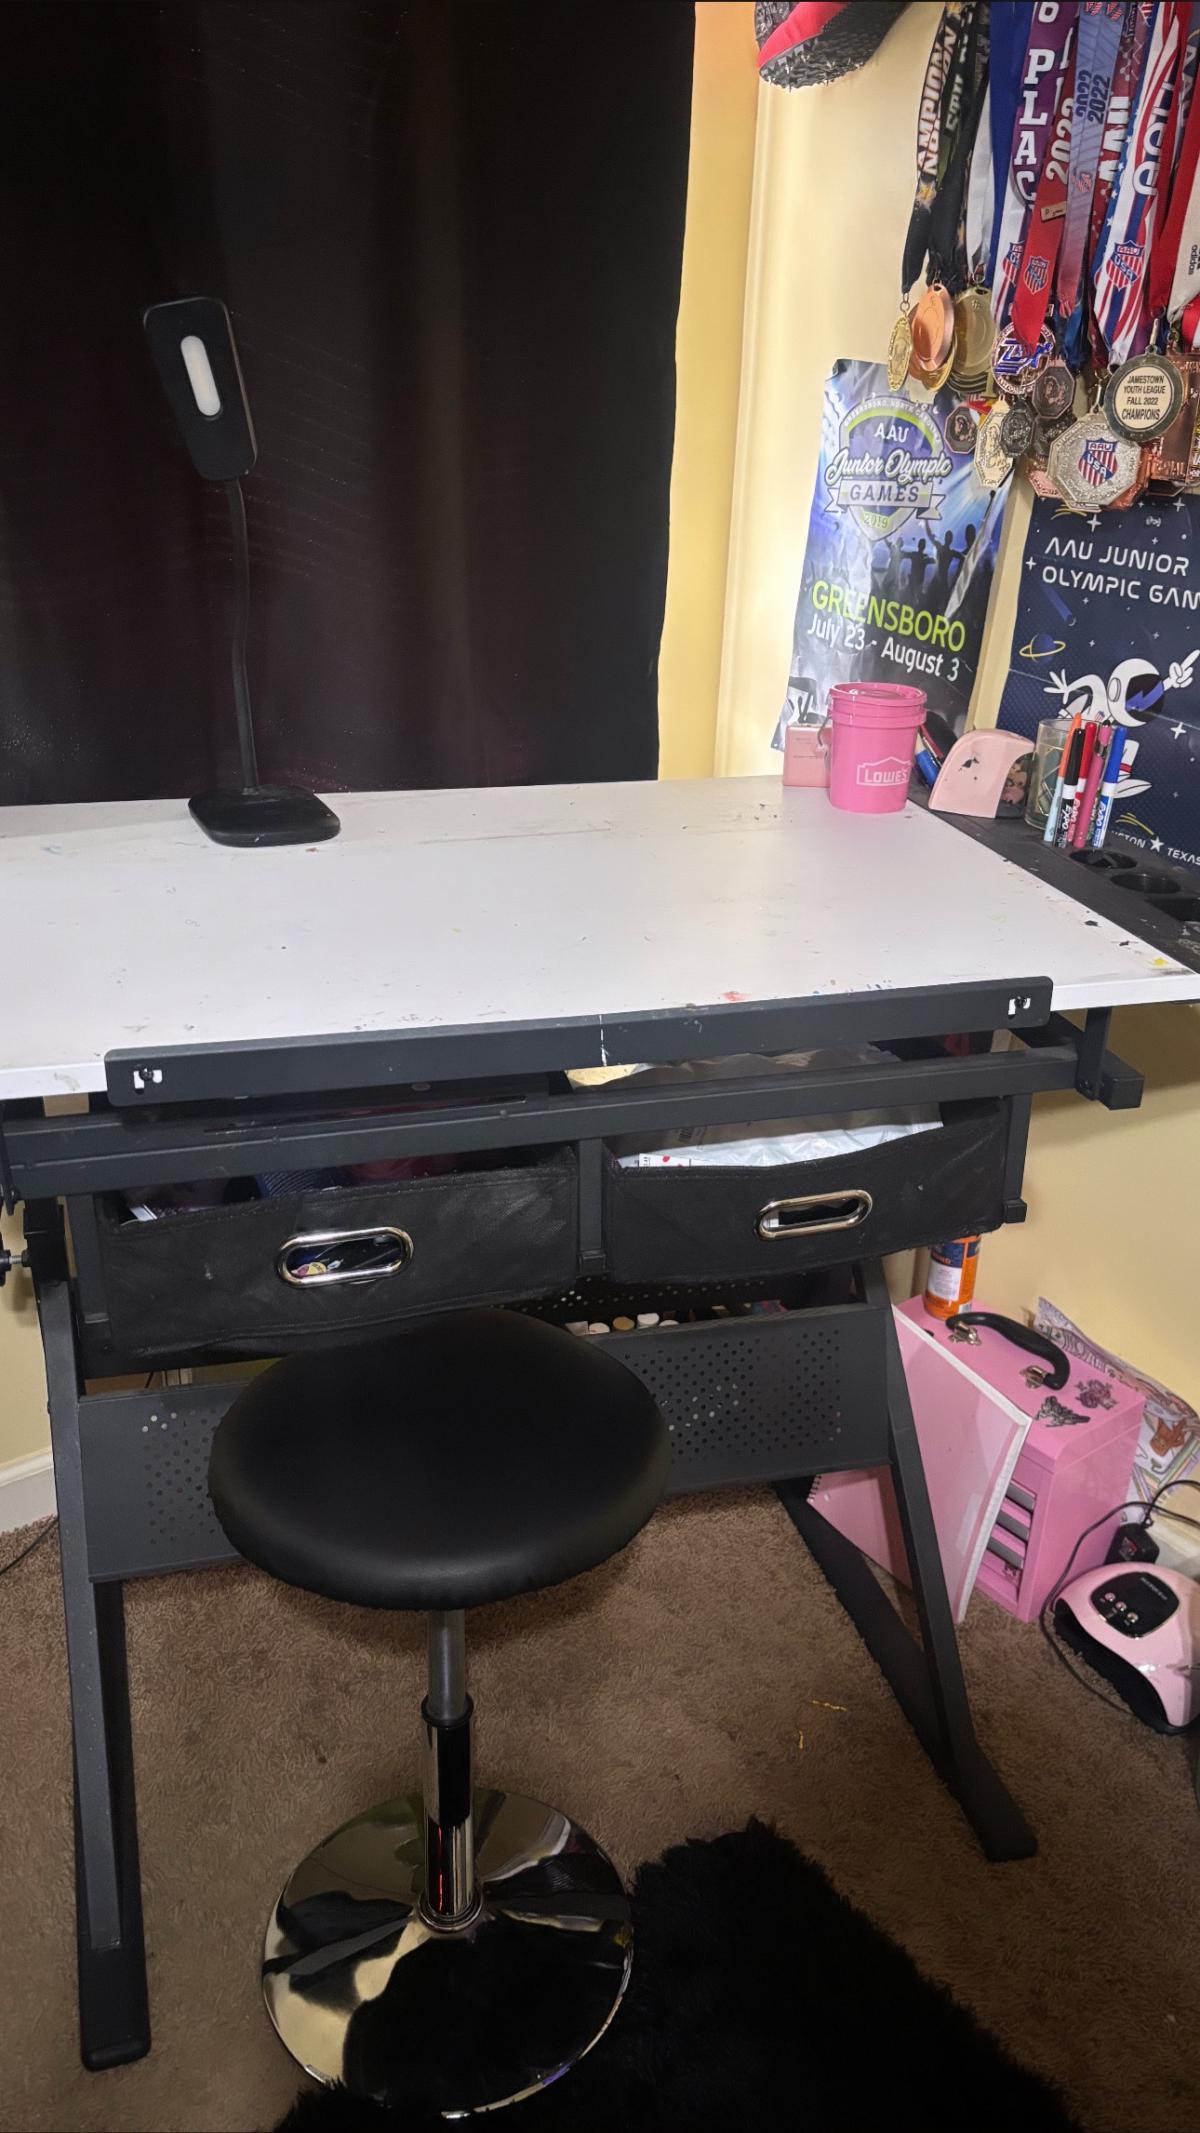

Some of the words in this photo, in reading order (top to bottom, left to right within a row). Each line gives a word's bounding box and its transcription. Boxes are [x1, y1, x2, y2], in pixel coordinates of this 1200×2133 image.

[1087, 75, 1111, 124] 2022
[1014, 49, 1056, 207] PLAC
[1188, 244, 1199, 275] adidas
[1124, 386, 1142, 394] YOUTH
[1143, 386, 1166, 394] LEAGUE
[1127, 375, 1165, 384] JAMESTOWN
[1121, 408, 1161, 420] CHAMPIONS
[1127, 397, 1142, 405] FALL
[1144, 397, 1159, 406] 2022
[874, 422, 909, 443] AAU
[826, 449, 884, 485] Junior
[885, 449, 952, 485] Olympic
[1087, 453, 1107, 478] USA
[850, 484, 919, 502] GAMES
[863, 514, 889, 529] 2019
[1044, 536, 1094, 561] AAU
[1098, 545, 1190, 577] JUNIOR
[1042, 566, 1142, 600] OLYMPIC
[812, 580, 966, 652] GREENSBORO
[807, 613, 841, 648] July
[844, 625, 866, 650] 23
[881, 636, 944, 677] August
[946, 657, 960, 681] 3
[1062, 803, 1073, 830] EXPO
